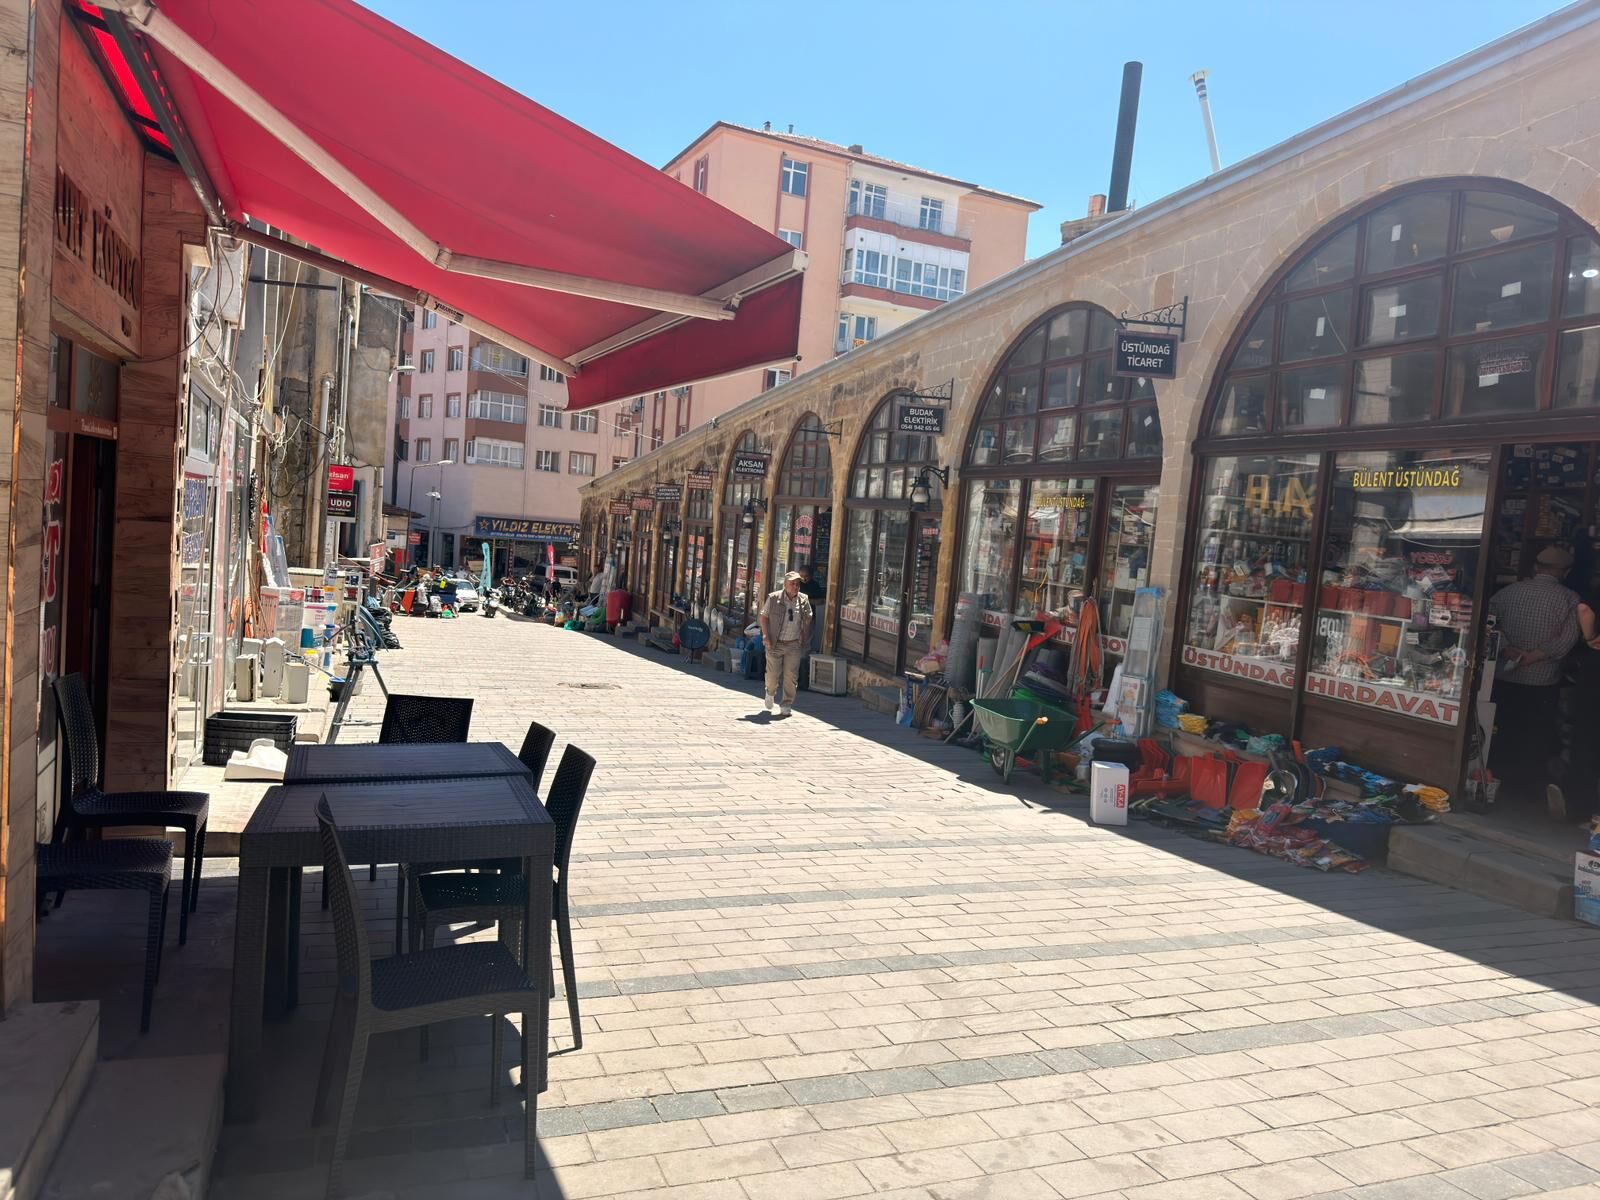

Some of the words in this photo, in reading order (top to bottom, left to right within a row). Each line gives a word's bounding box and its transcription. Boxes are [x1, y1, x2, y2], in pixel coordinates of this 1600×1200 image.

[1121, 340, 1170, 355] ÜSTÜNDAĞ
[1127, 354, 1163, 368] TİCARET
[909, 408, 934, 416] BUDAK
[903, 416, 938, 424] ELEKTİRİK
[738, 460, 764, 469] AKSAN
[1353, 466, 1394, 488] BÜLENT
[1395, 465, 1459, 488] ÜSTÜNDAĞ
[531, 522, 575, 536] ELEKTR
[1184, 646, 1295, 689] ÜSTÜNDAĞ
[1307, 676, 1459, 722] HIRDAVAT
